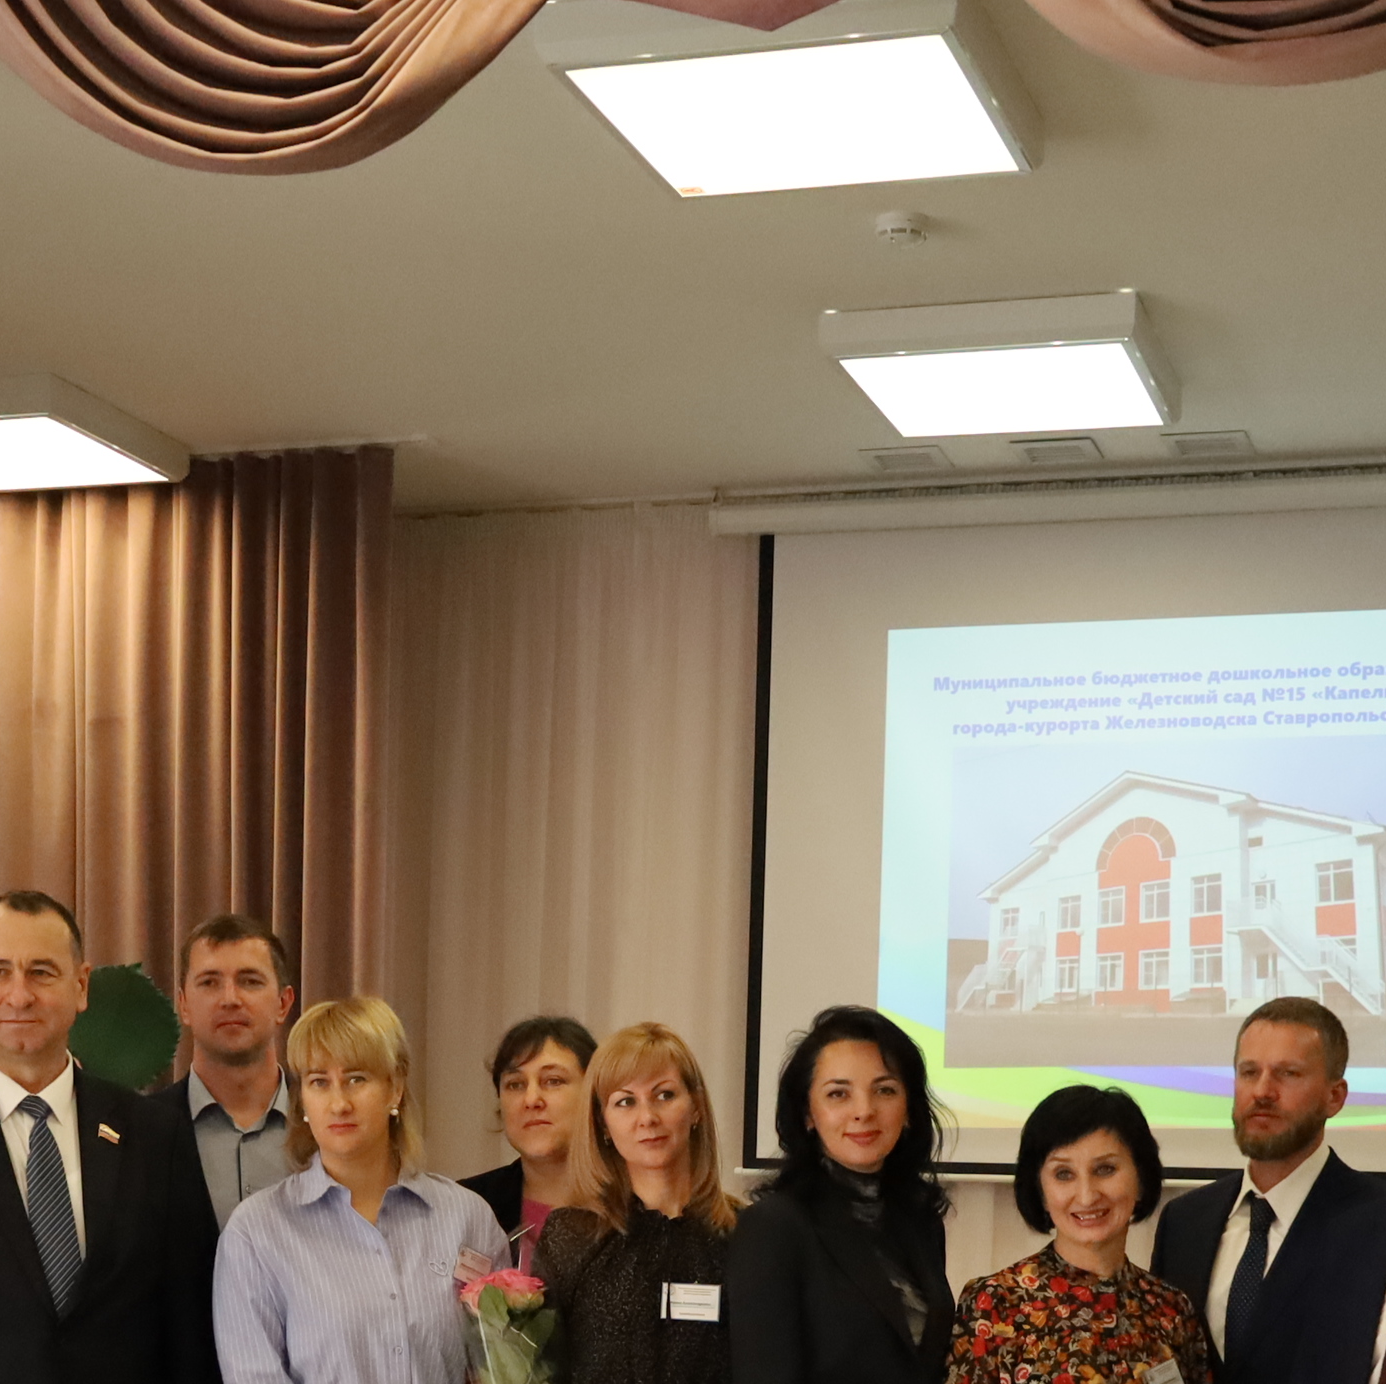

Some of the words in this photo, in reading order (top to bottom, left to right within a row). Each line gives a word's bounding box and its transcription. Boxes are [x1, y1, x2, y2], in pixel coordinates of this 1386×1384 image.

[933, 675, 1086, 694] Муниципальное
[1091, 671, 1202, 688] бюджетное
[1207, 666, 1331, 683] дошкольное
[1006, 696, 1121, 714] учреждение
[1127, 690, 1218, 710] «Детский
[1223, 690, 1256, 706] сад
[1262, 687, 1306, 703] №15
[953, 718, 1099, 737] города-курорта
[1105, 714, 1256, 731] Железноводска
